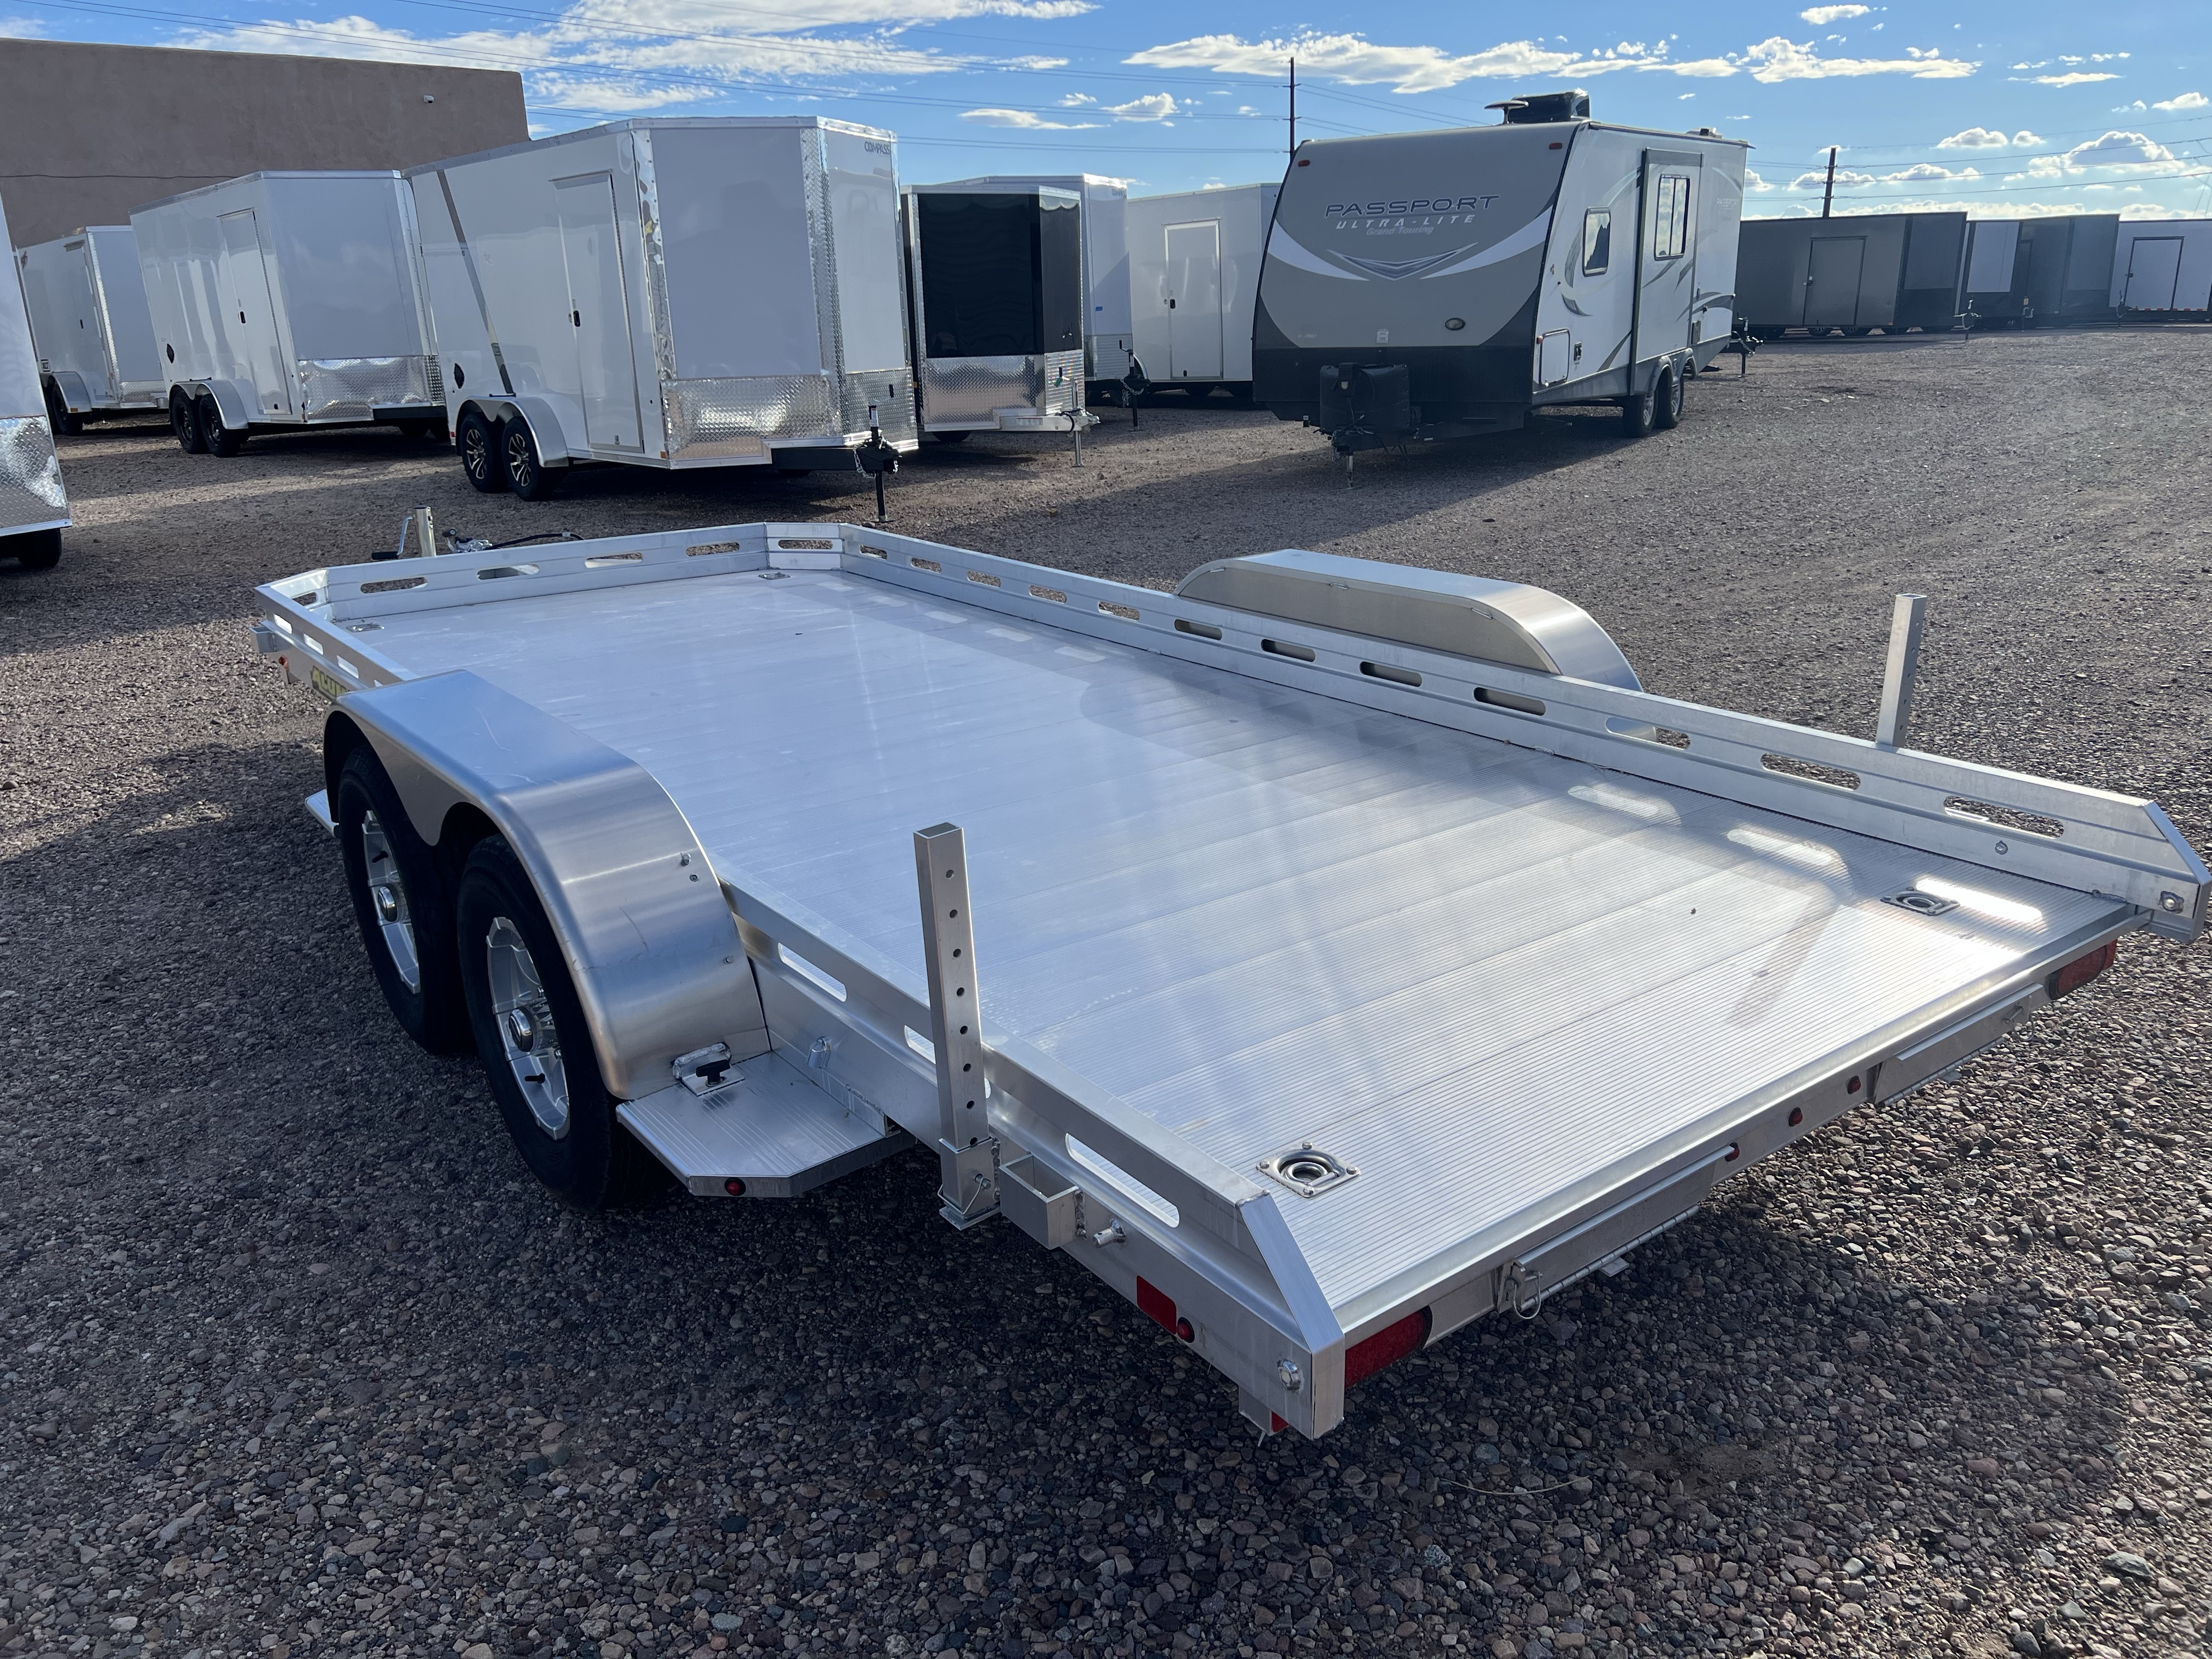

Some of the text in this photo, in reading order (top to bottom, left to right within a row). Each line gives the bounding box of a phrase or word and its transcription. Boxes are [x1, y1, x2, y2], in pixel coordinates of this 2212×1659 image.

[864, 141, 890, 155] COMPASS
[1324, 195, 1500, 218] PASSPORT
[1336, 215, 1476, 229] ULTRA-LITE
[1366, 226, 1435, 236] Grand Touring
